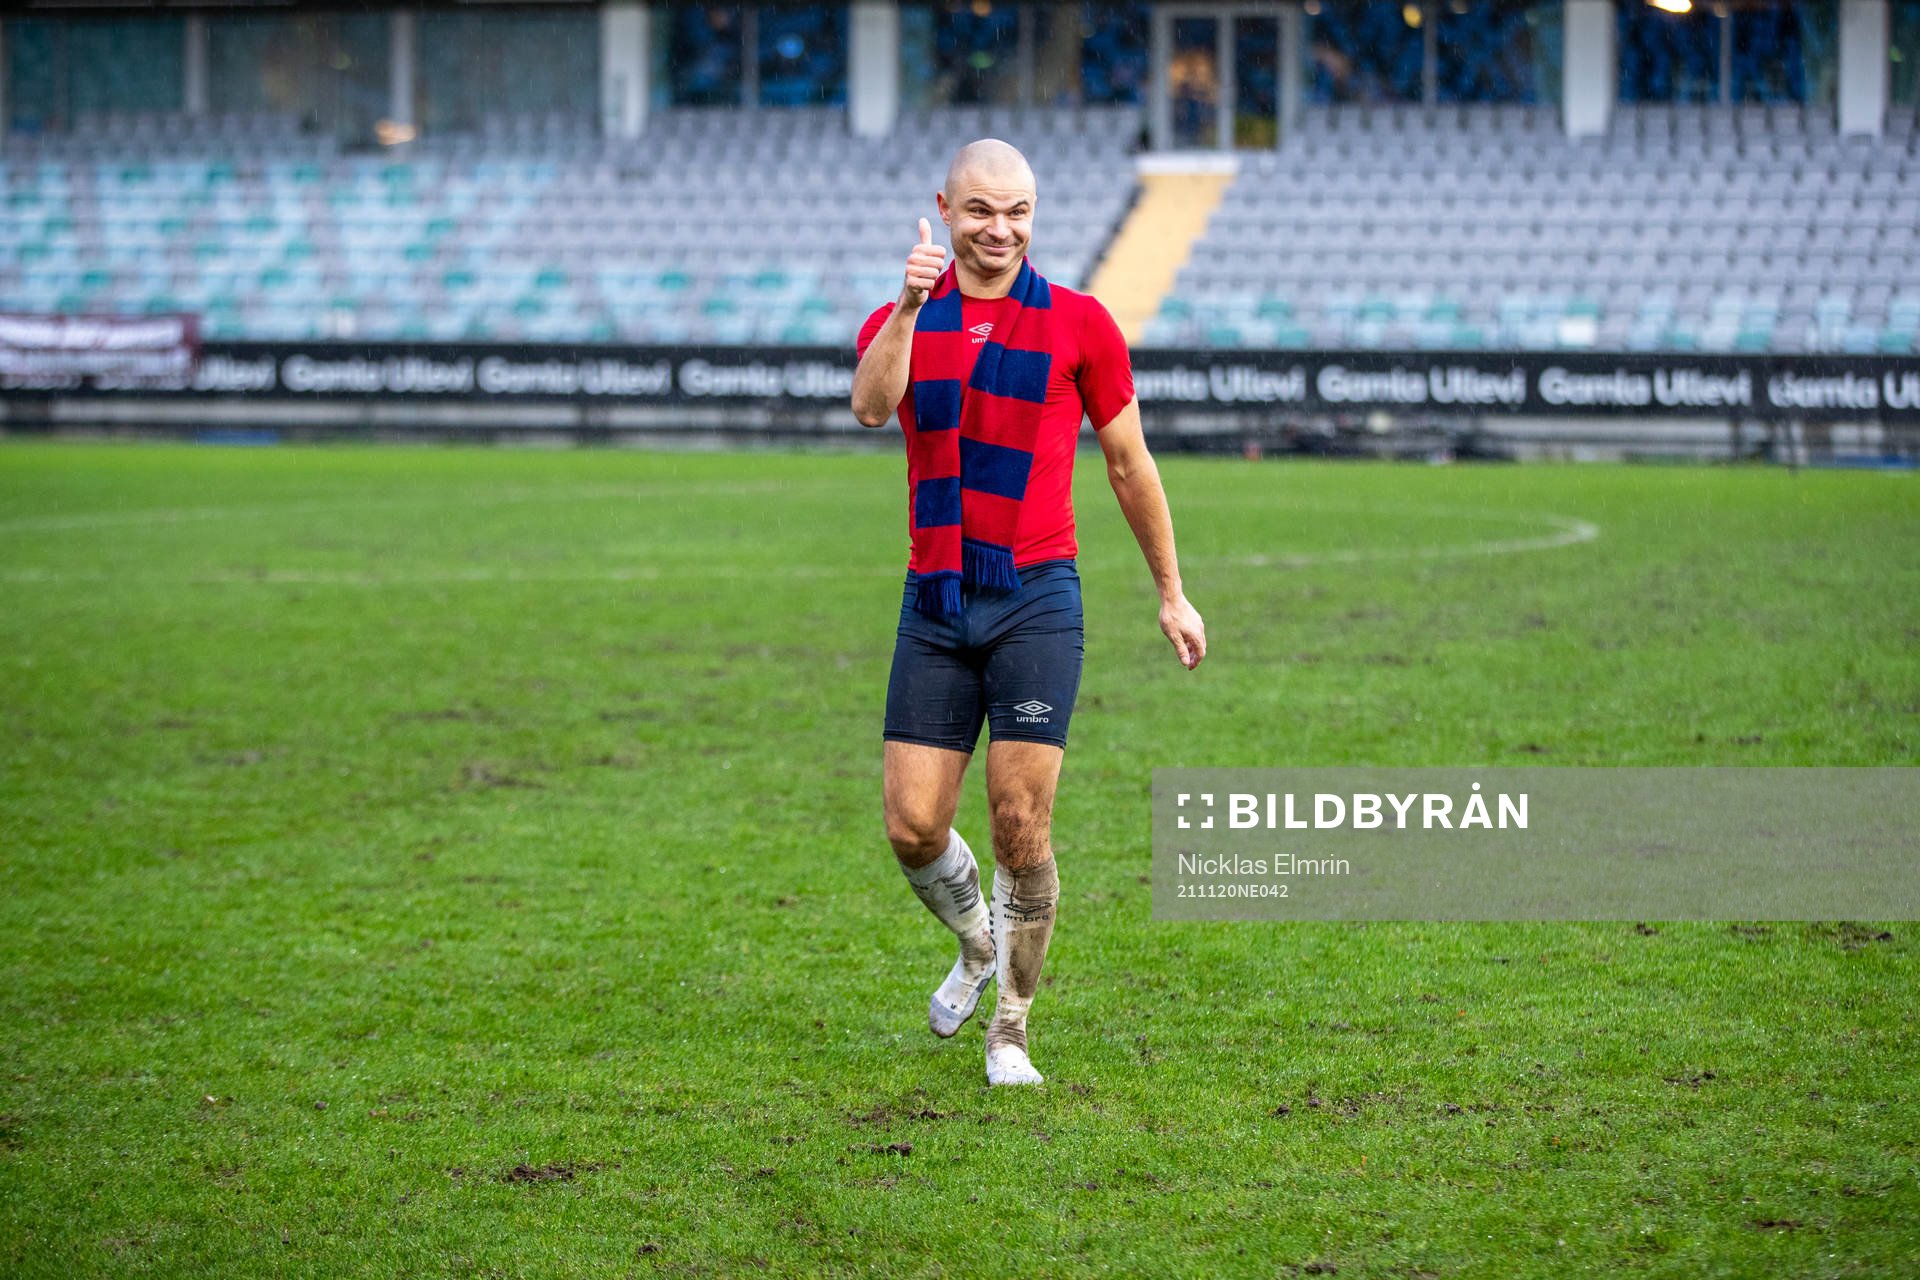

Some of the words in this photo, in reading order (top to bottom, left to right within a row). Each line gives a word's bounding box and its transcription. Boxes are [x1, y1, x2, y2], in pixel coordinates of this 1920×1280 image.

[1131, 365, 1209, 401] amla
[1209, 365, 1307, 402] Ullevi
[1317, 365, 1428, 402] Gamla
[1429, 366, 1527, 404] Ullevi
[1538, 366, 1652, 406] Gamla
[1653, 368, 1753, 407] Ullevi
[1016, 715, 1050, 724] umbro
